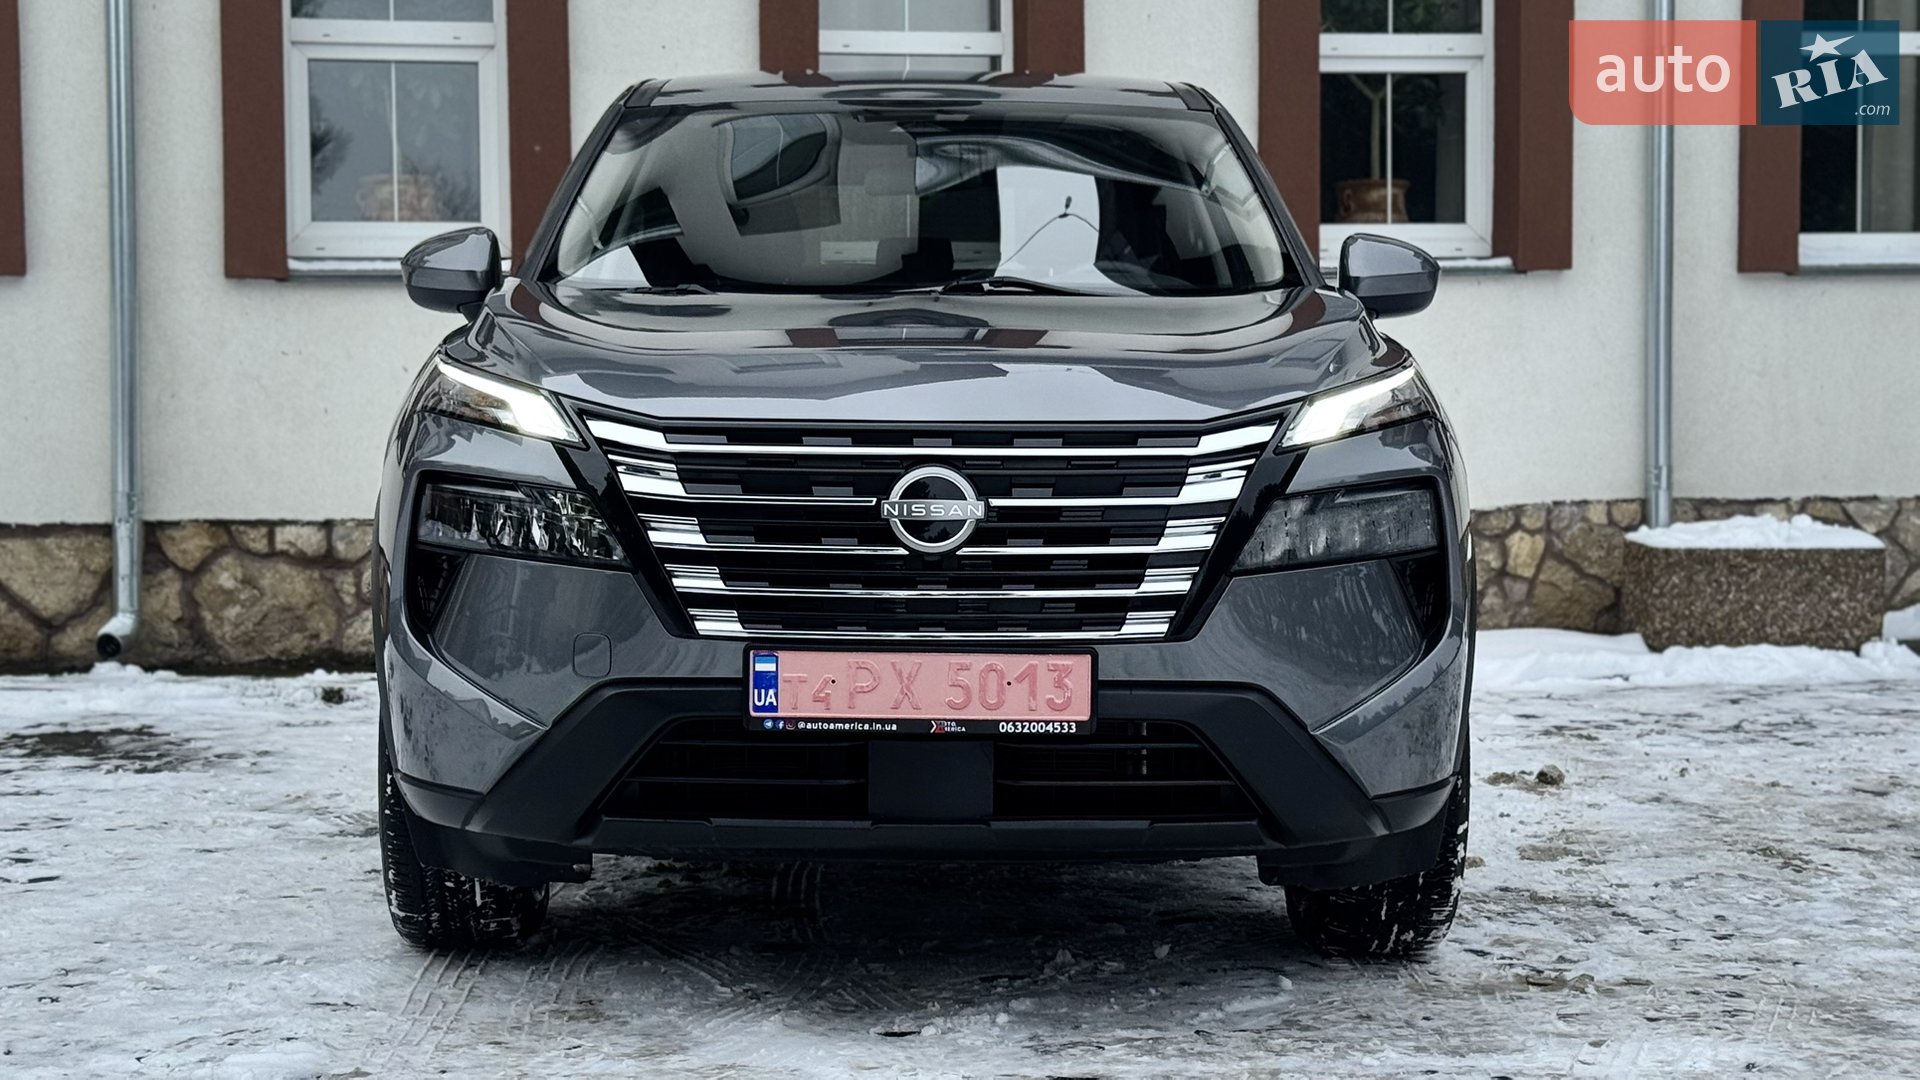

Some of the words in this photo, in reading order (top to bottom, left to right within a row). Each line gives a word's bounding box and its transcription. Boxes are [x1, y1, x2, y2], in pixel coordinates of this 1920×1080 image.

[883, 503, 982, 517] NISSAN
[945, 660, 1073, 711] 5013
[754, 689, 777, 706] UA
[797, 721, 897, 731] @autoamerica.in.ua
[999, 722, 1076, 733] 0632004533
